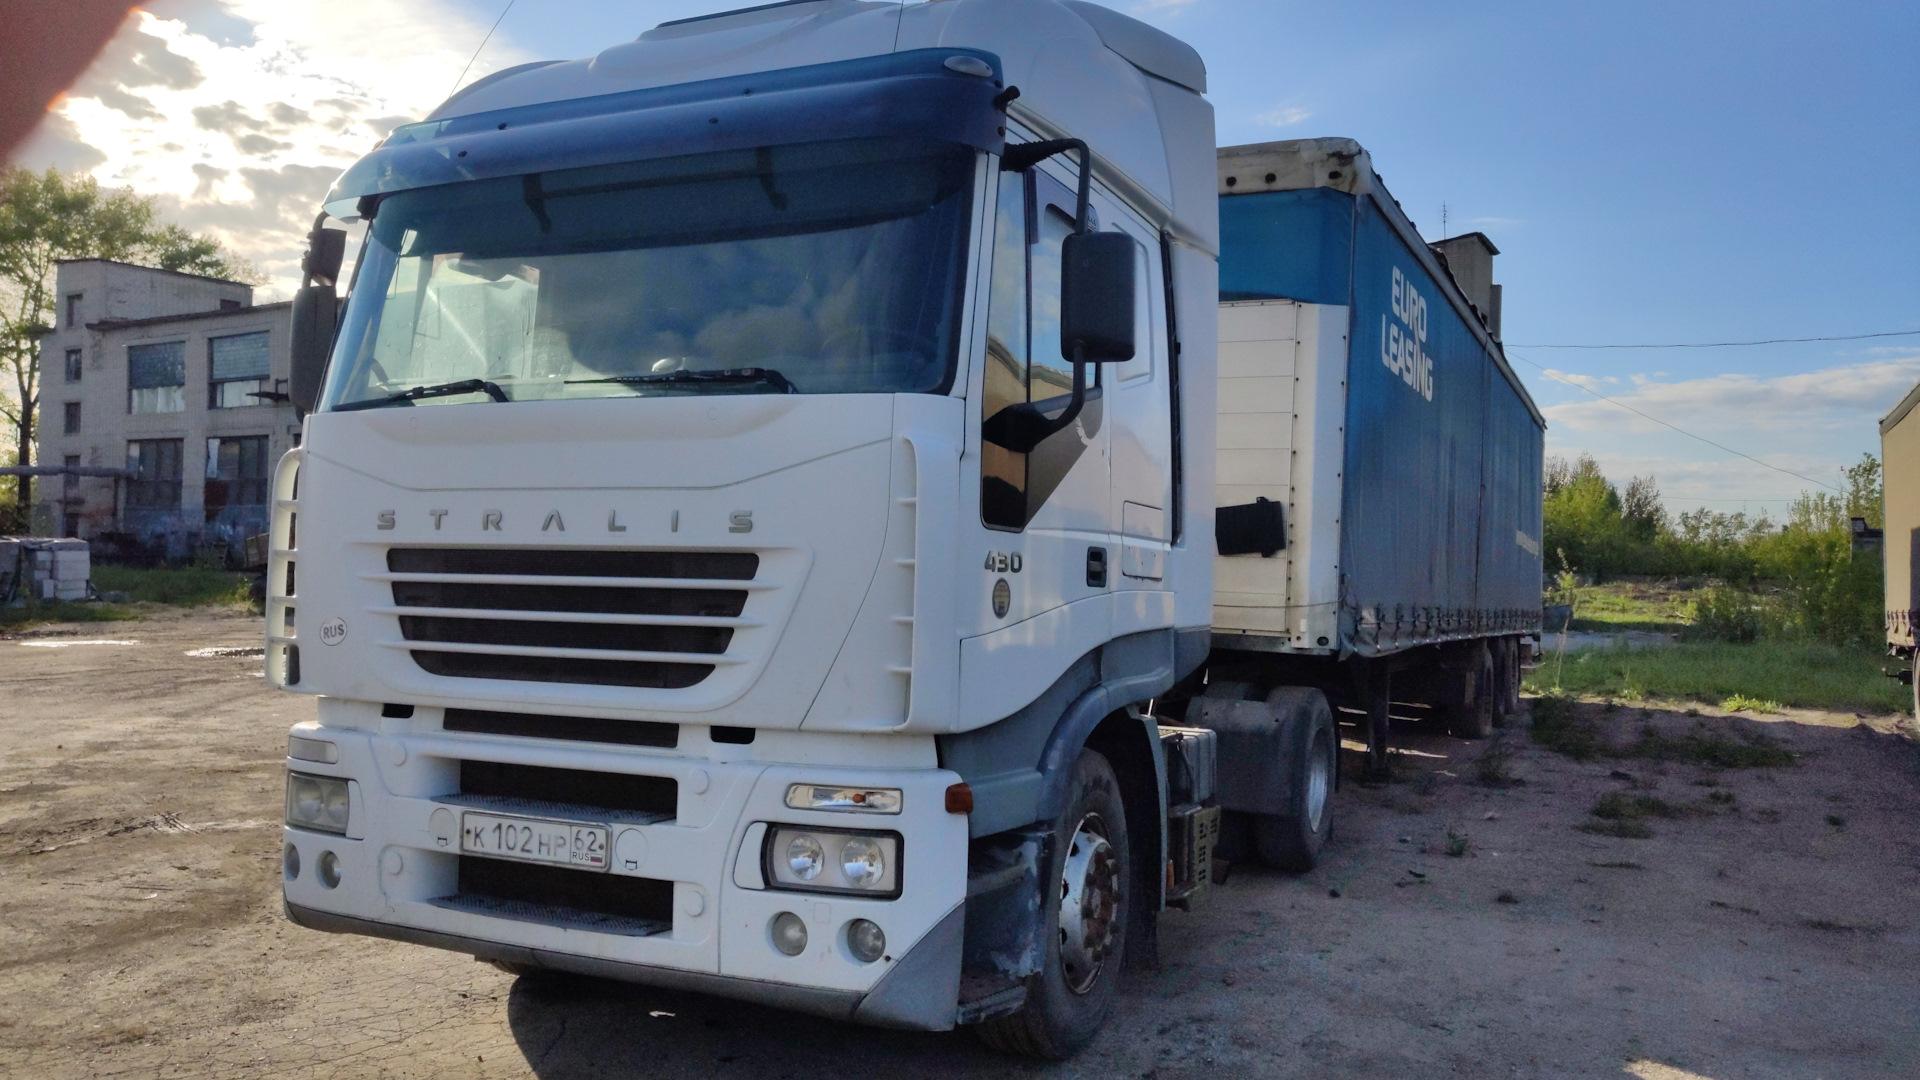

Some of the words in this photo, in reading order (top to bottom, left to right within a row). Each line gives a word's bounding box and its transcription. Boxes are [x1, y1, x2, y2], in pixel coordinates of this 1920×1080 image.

[1391, 265, 1427, 343] EURO
[1381, 313, 1433, 402] LEASING
[376, 509, 754, 534] STRALIS
[984, 550, 1023, 573] 430
[323, 623, 345, 640] RUS
[574, 829, 598, 852] 62
[572, 851, 590, 861] RUS
